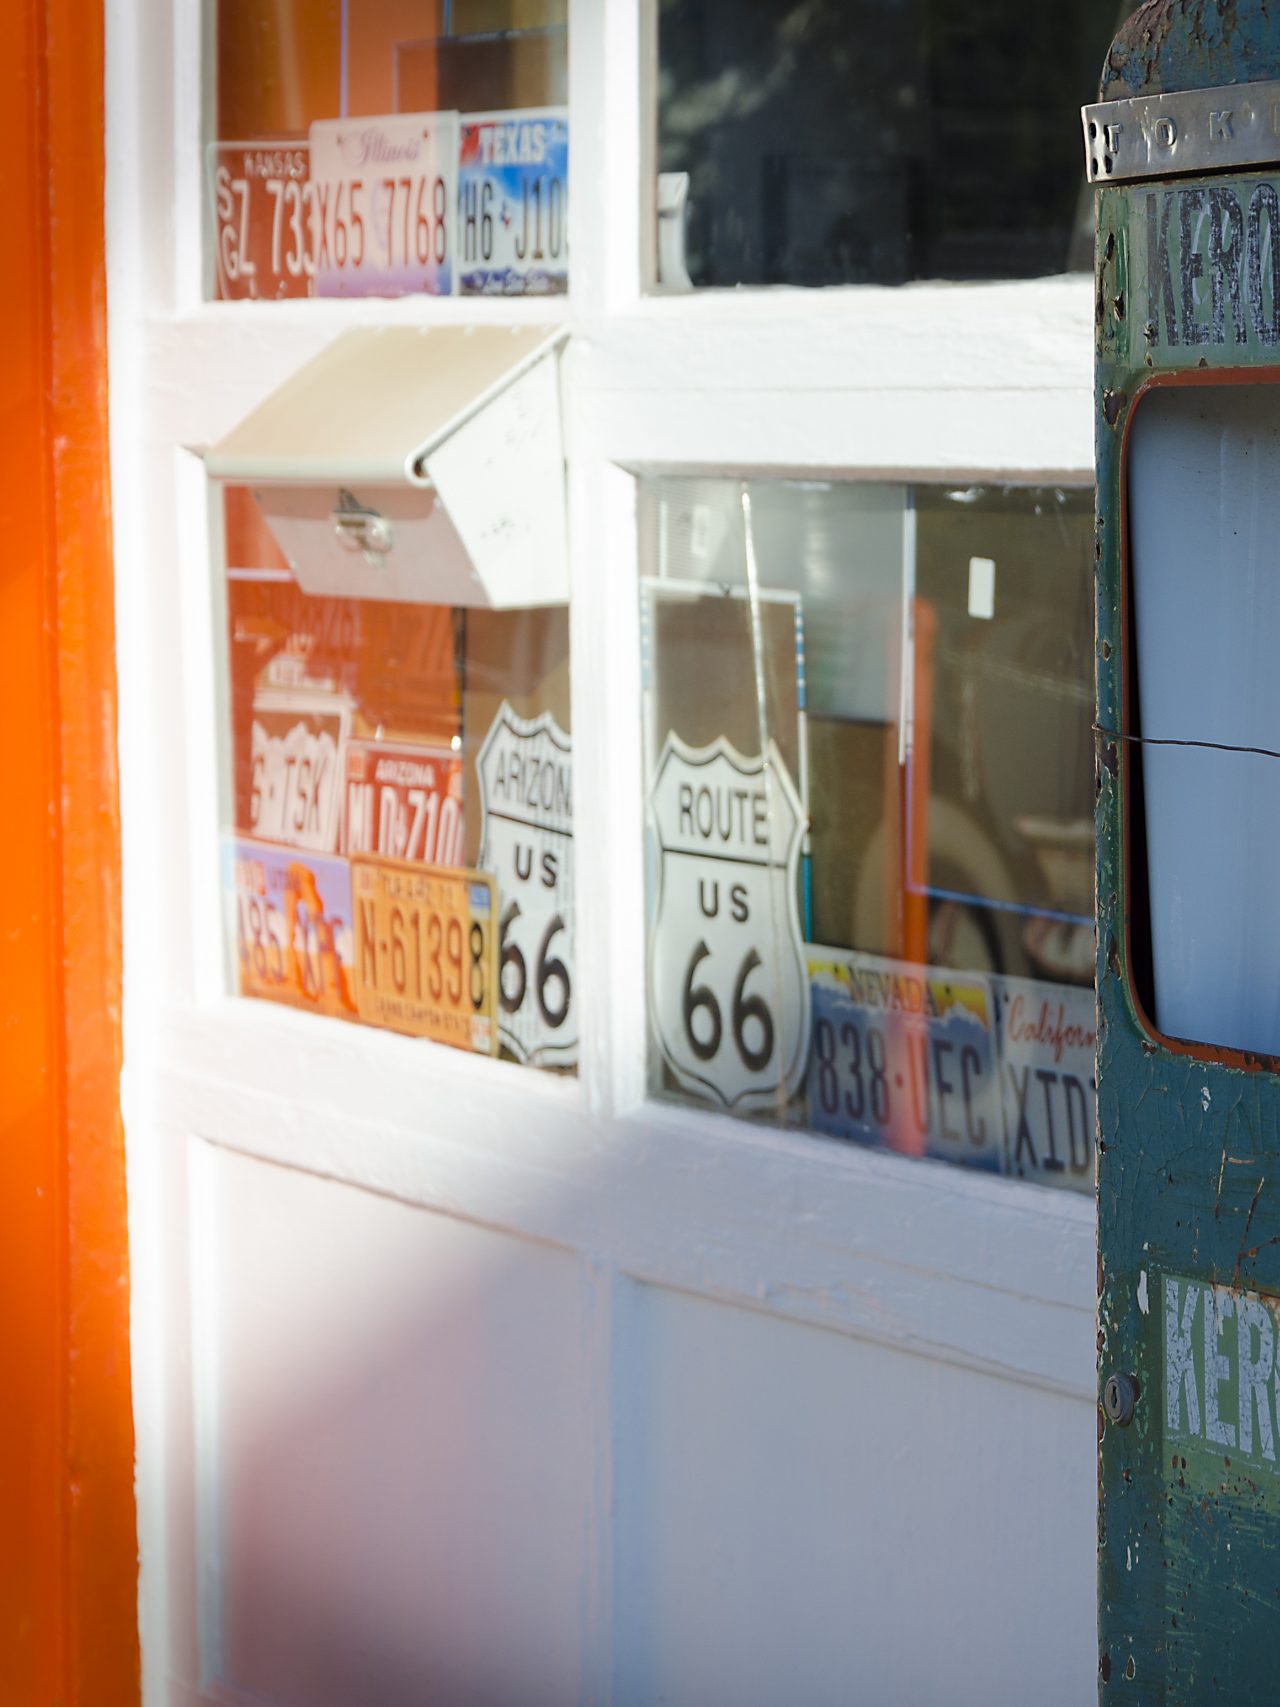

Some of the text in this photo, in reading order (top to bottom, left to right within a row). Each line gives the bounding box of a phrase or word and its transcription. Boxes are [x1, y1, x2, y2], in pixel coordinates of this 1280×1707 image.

[243, 151, 306, 177] KANSAS
[343, 127, 422, 168] Illinois
[479, 123, 546, 165] TEXAS
[383, 176, 447, 267] 7768
[375, 758, 436, 788] ARIZONA
[494, 749, 573, 818] ARIZON
[679, 781, 770, 848] ROUTE
[515, 842, 559, 889] US
[700, 877, 750, 925] US
[500, 900, 571, 1030] 66
[847, 962, 940, 1016] NEVADA
[683, 939, 774, 1073] 66
